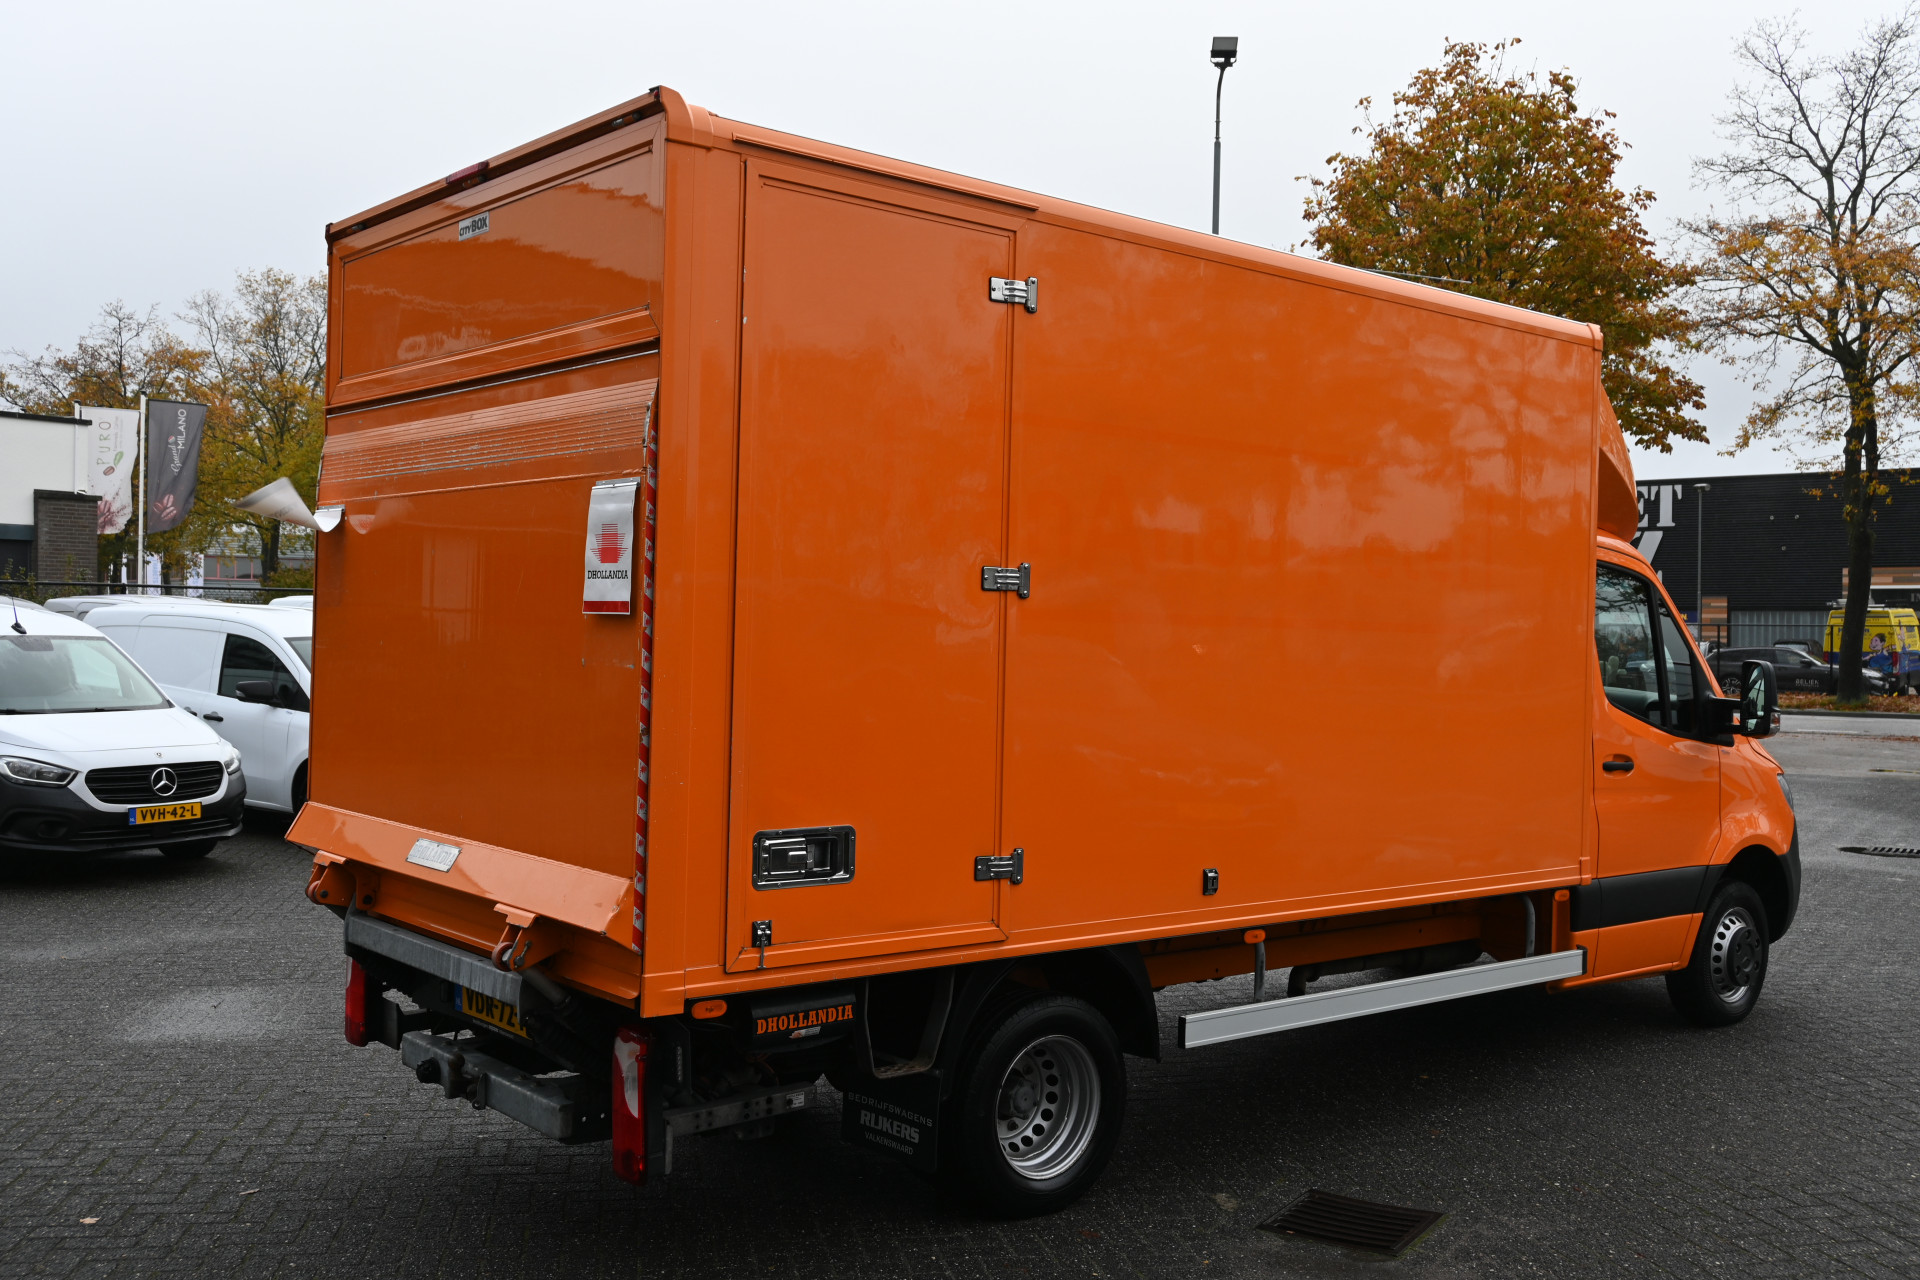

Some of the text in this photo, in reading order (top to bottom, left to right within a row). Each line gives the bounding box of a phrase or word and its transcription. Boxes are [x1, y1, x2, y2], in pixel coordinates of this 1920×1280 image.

[96, 421, 112, 465] PURO
[177, 408, 187, 449] MILANO
[587, 570, 629, 580] DHOLLANDIA
[140, 805, 197, 821] VVH-42-L
[756, 1004, 854, 1035] DHOLLANDIA
[848, 1091, 933, 1127] BEDRIJFSWAGENS
[860, 1109, 920, 1144] RIJKERS
[864, 1131, 914, 1155] VALKENSWAARD
